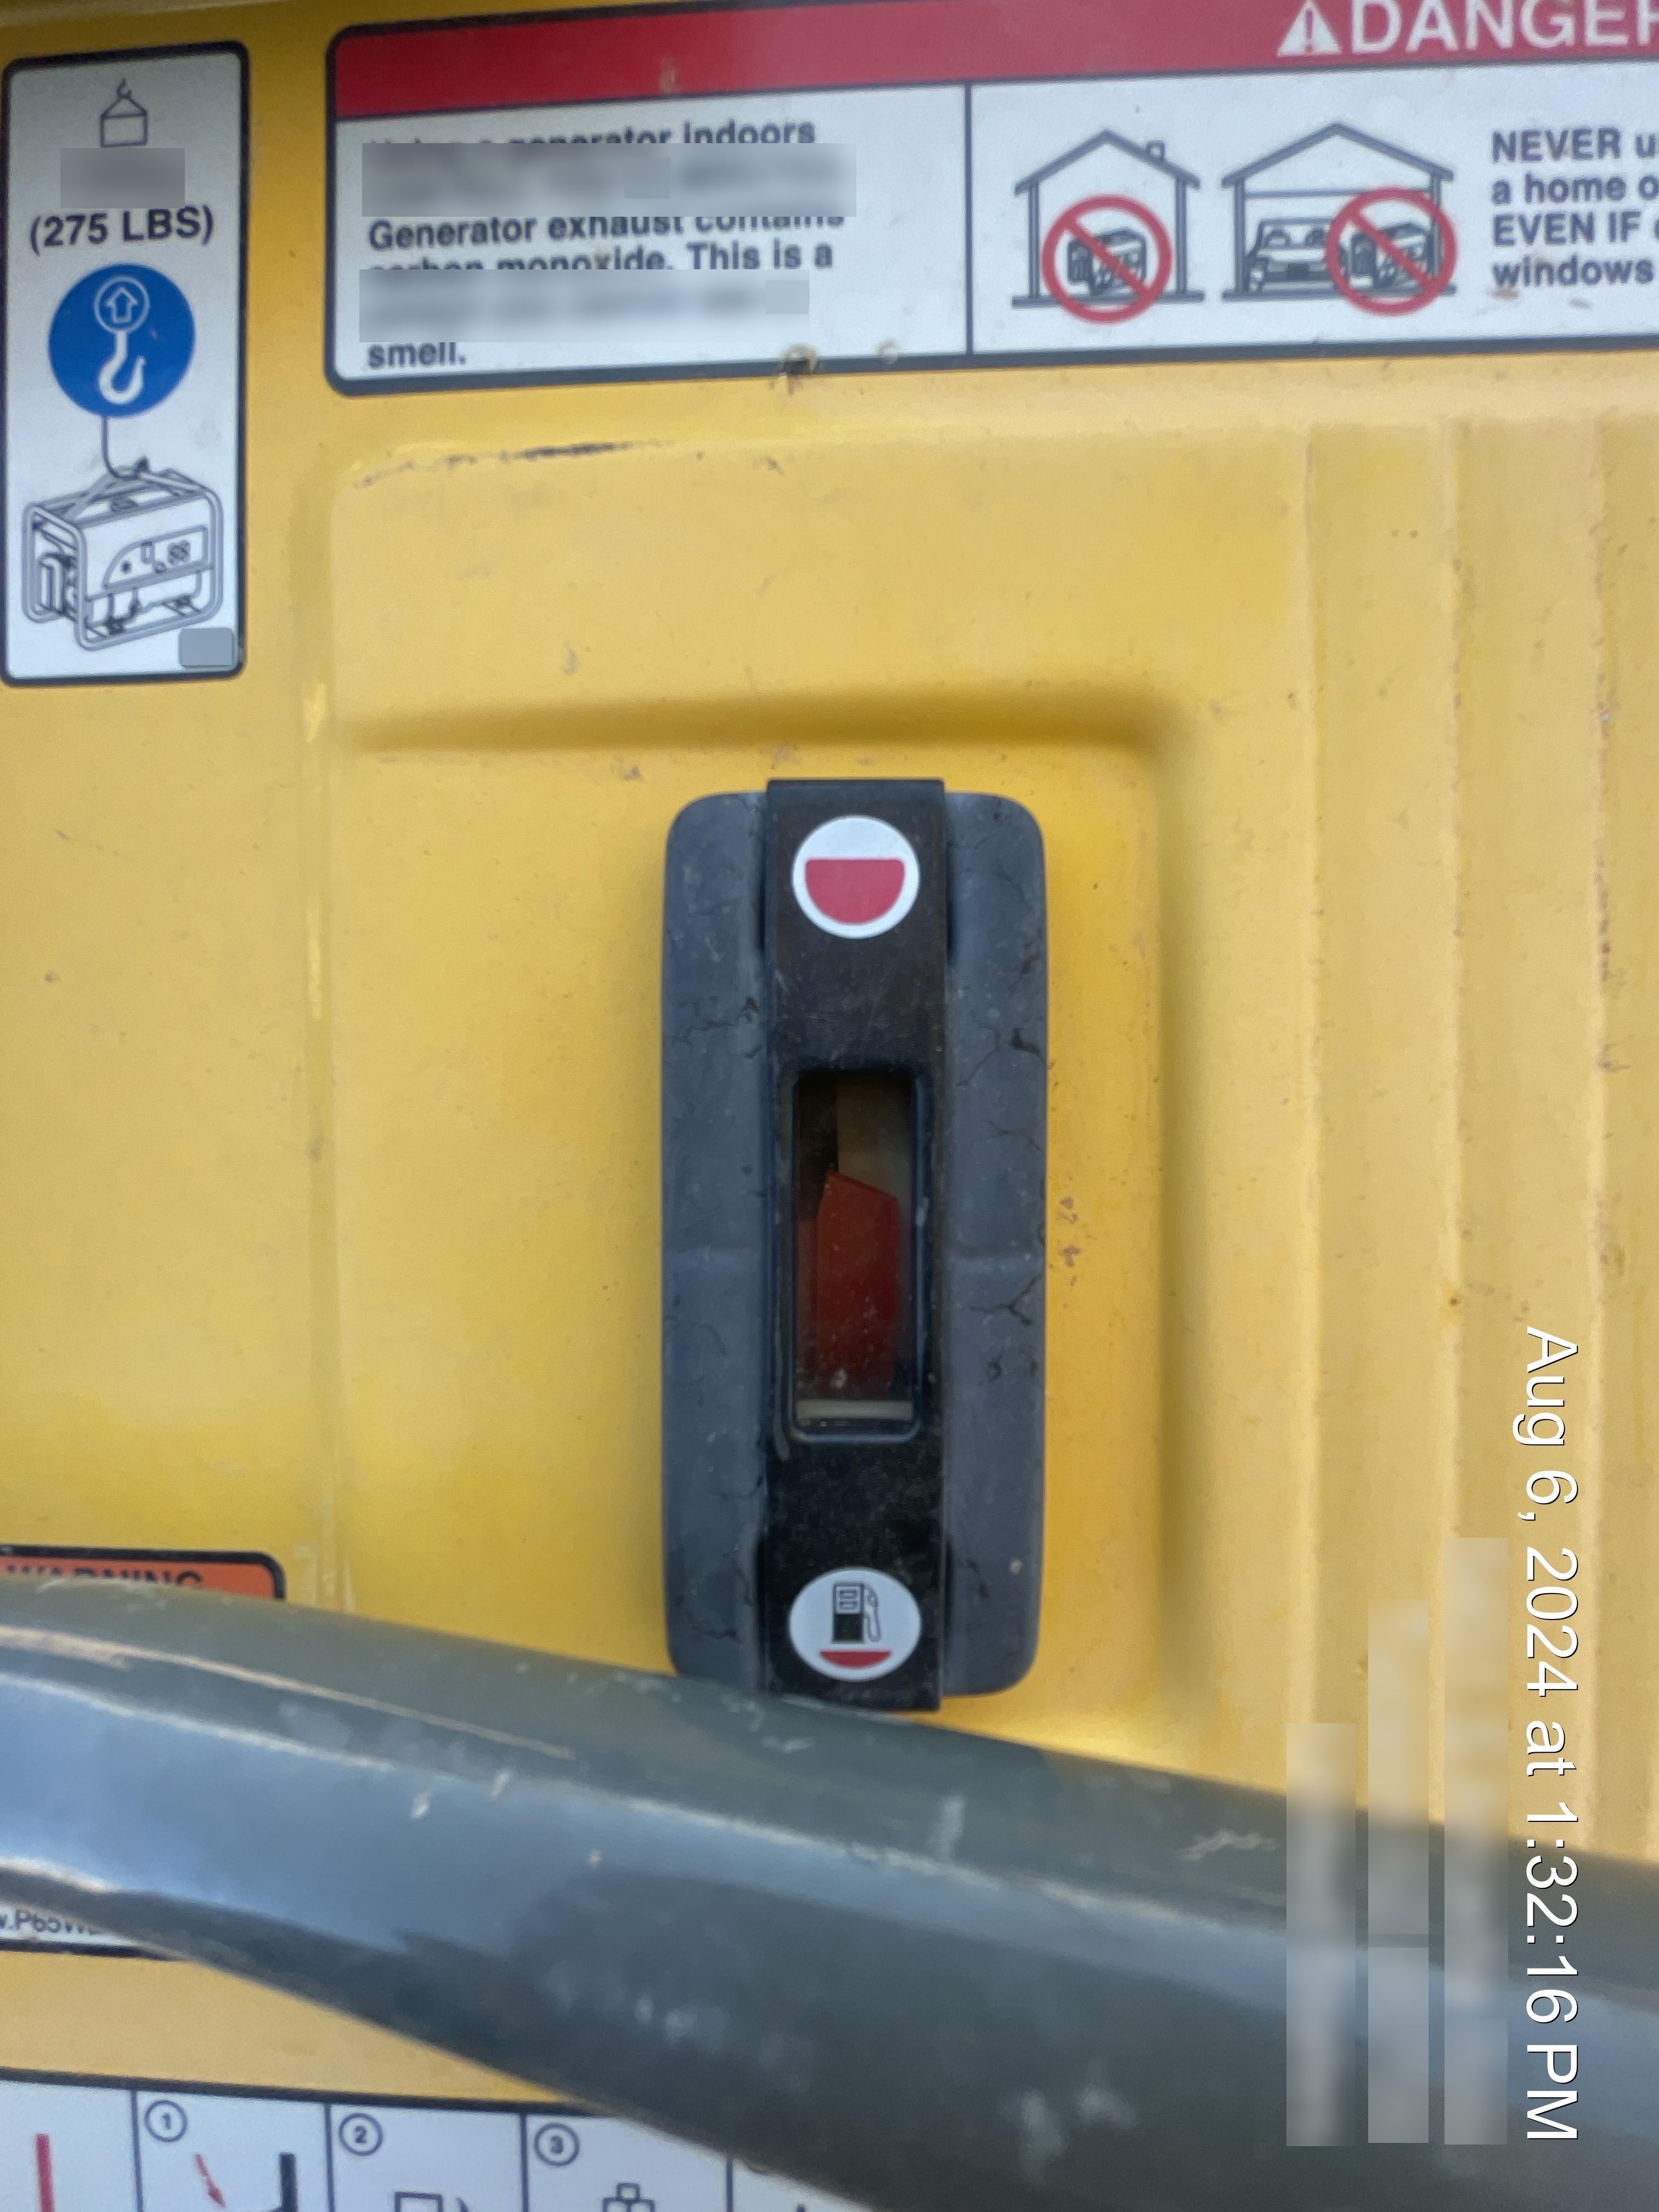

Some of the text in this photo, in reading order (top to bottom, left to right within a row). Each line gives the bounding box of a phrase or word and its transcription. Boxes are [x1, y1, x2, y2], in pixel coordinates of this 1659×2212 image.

[1492, 127, 1622, 163] NEVER
[1492, 179, 1511, 205] a
[1525, 171, 1627, 205] home
[30, 202, 215, 256] (275 LBS)
[369, 216, 538, 250] Generator
[548, 216, 684, 242] exhaust
[1493, 211, 1595, 246] EVEN
[1609, 209, 1641, 243] IF
[686, 239, 760, 270] This
[773, 237, 802, 270] is
[814, 243, 833, 269] a
[1492, 253, 1654, 289] windows
[368, 342, 466, 368] smell.
